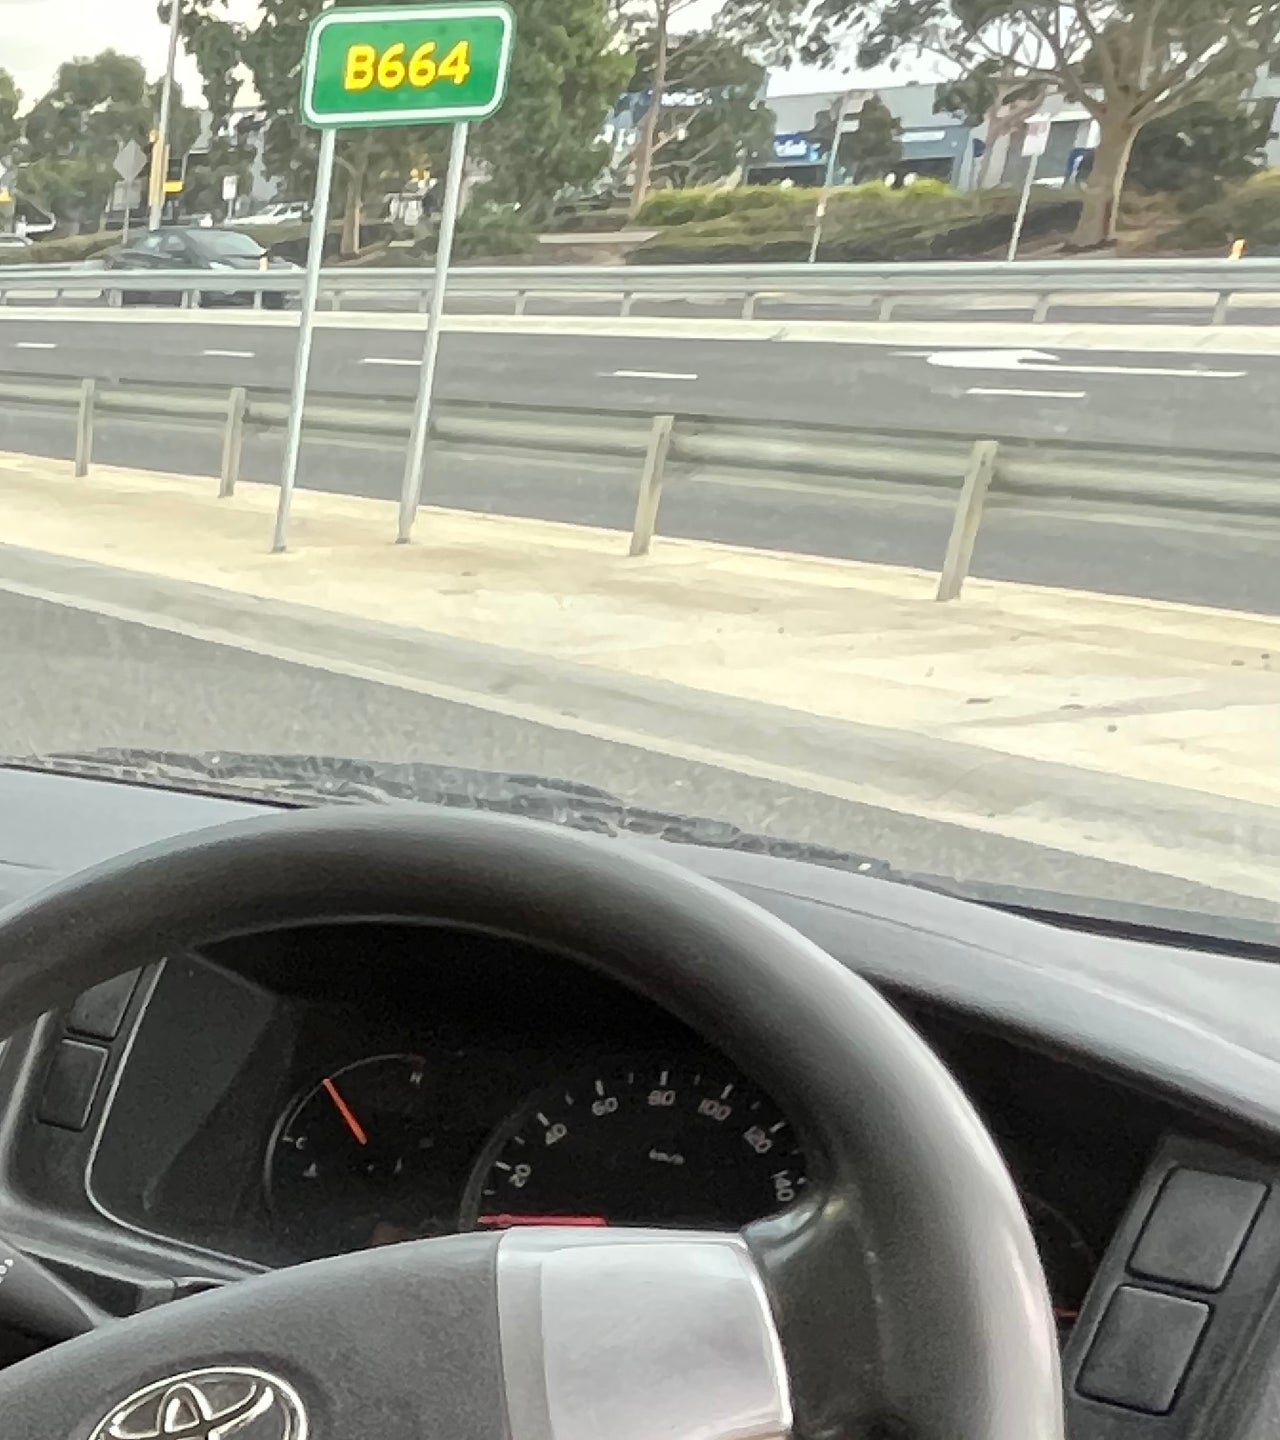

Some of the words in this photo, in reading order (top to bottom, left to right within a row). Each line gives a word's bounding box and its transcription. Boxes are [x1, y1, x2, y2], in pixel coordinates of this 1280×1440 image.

[344, 40, 471, 92] B664
[592, 1097, 619, 1117] 60
[648, 1090, 676, 1106] 80
[697, 1098, 732, 1121] 100
[545, 1122, 568, 1146] 40
[508, 1163, 532, 1189] 20
